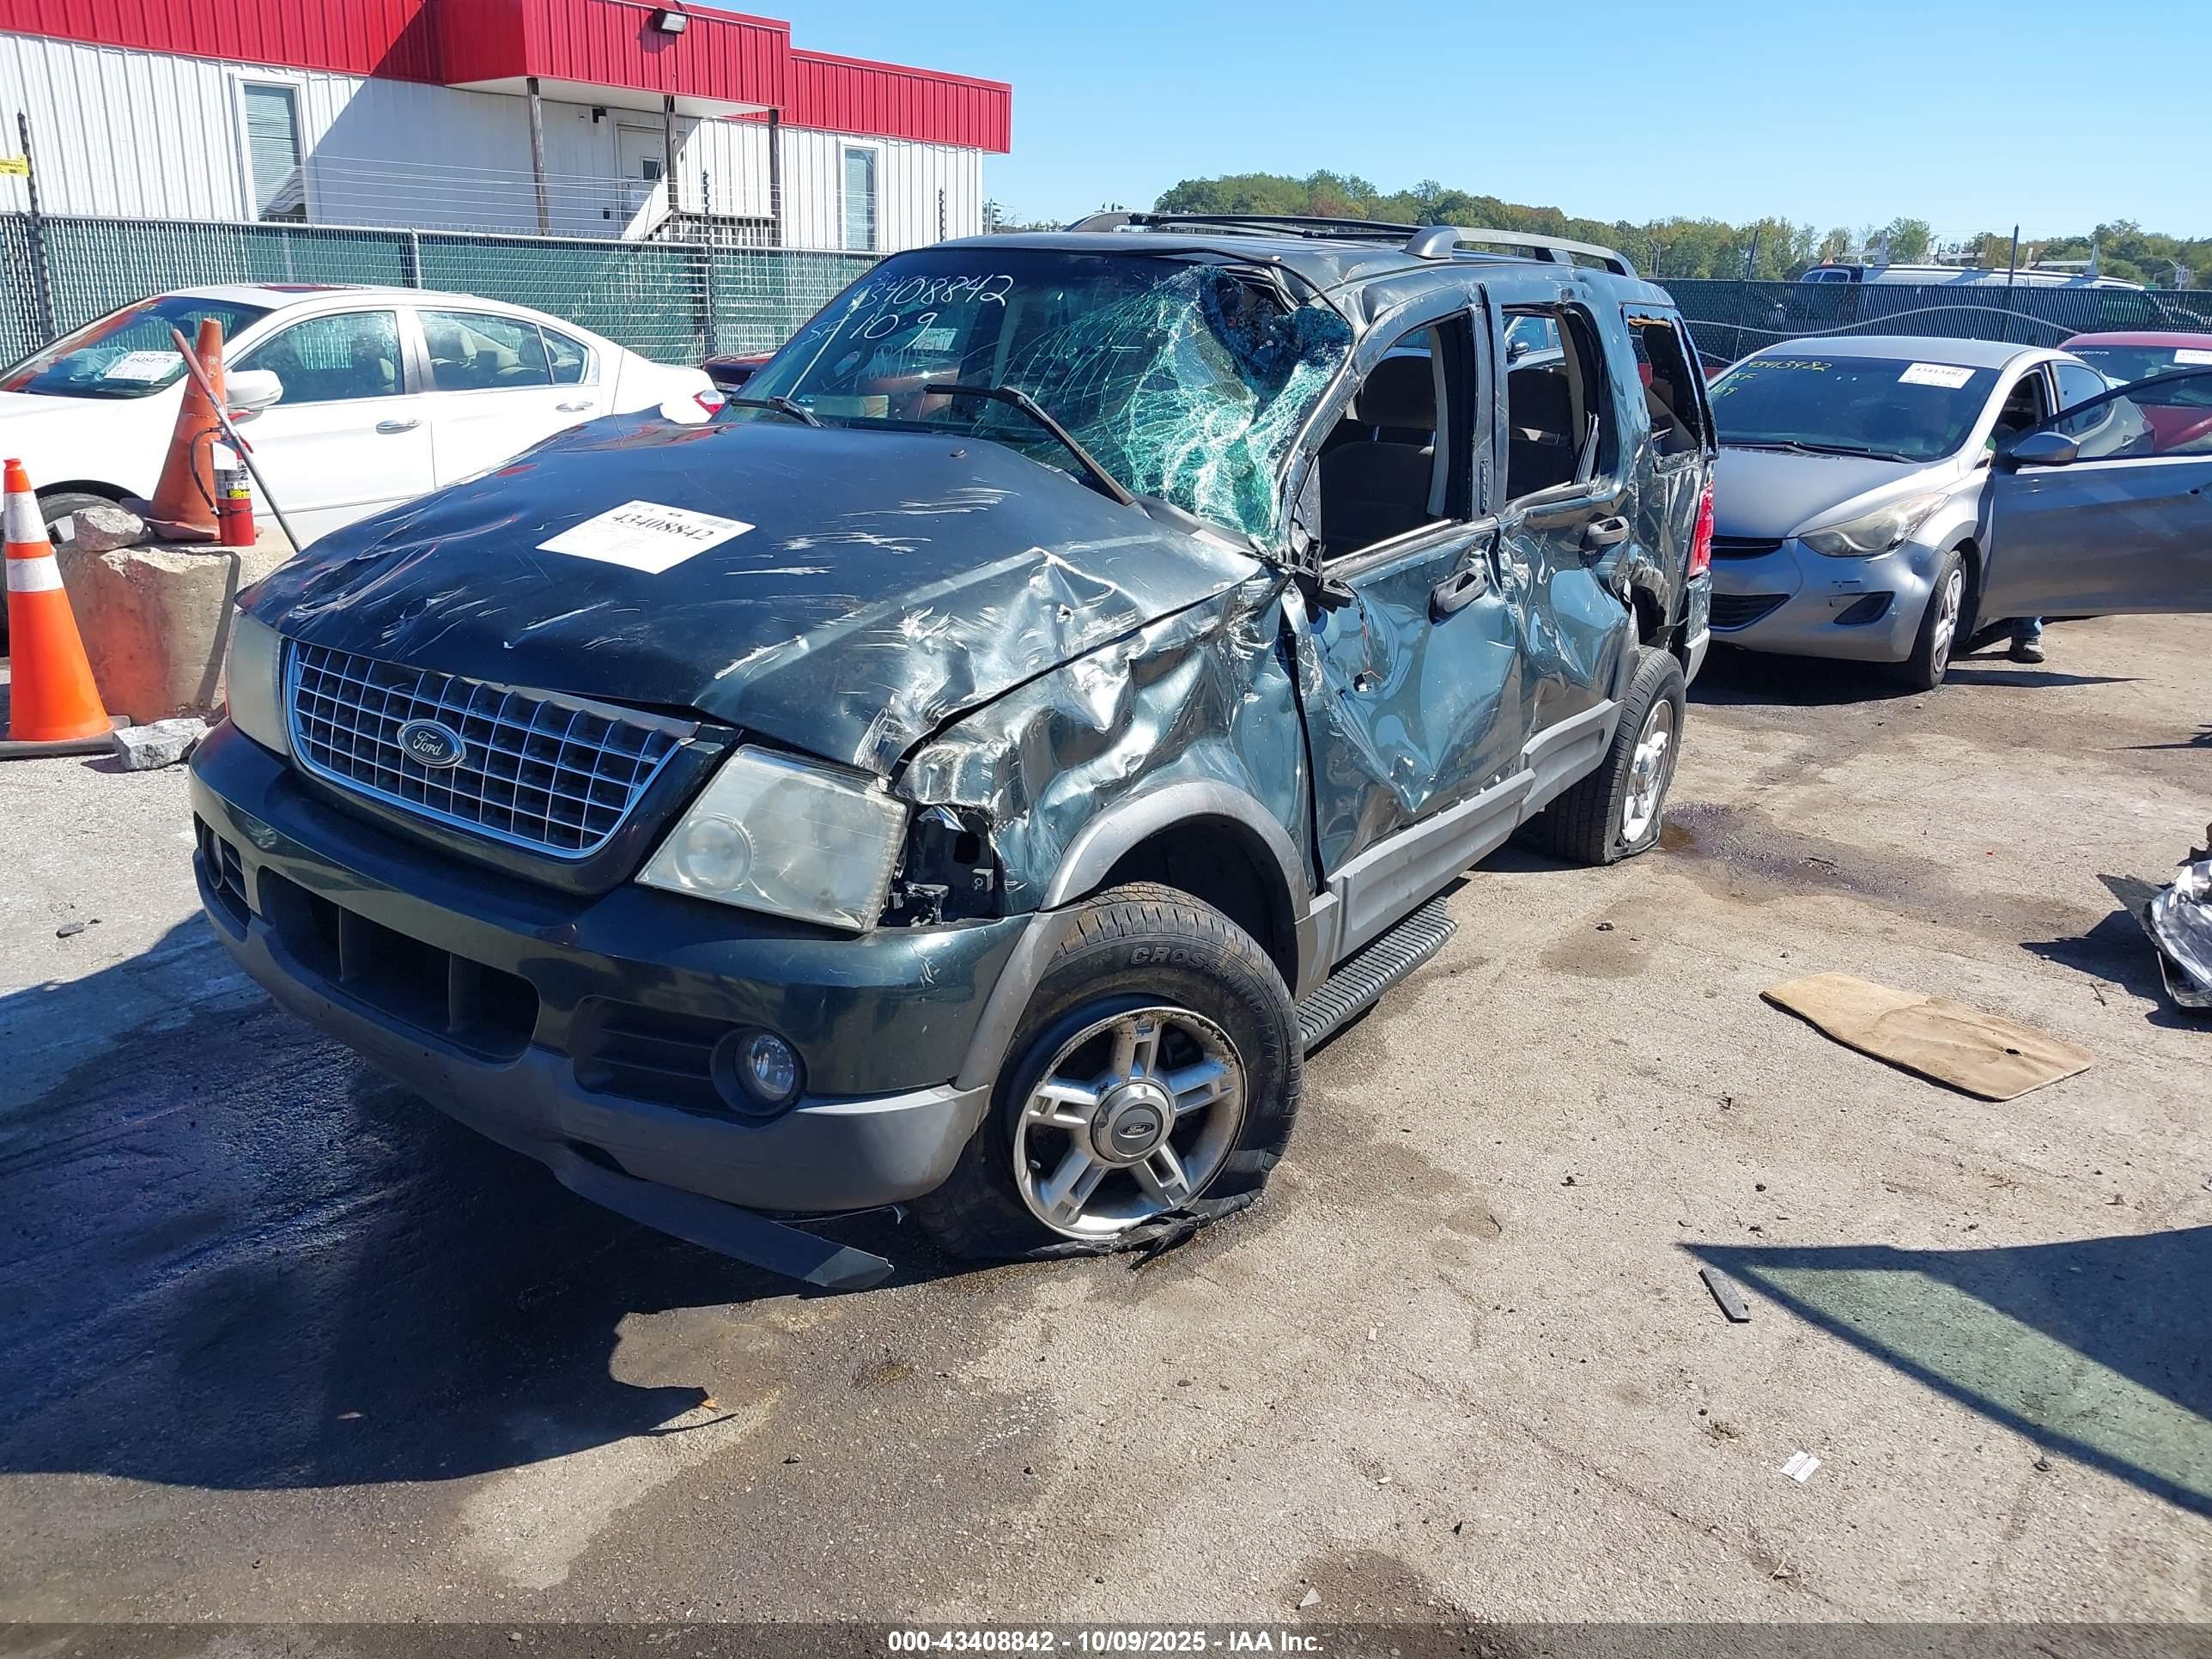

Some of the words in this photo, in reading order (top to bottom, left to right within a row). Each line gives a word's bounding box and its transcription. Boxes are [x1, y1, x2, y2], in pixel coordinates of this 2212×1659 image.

[2178, 271, 2188, 281] 10
[847, 275, 1014, 309] 43408842
[611, 514, 714, 540] 43408842
[413, 731, 444, 756] Ford
